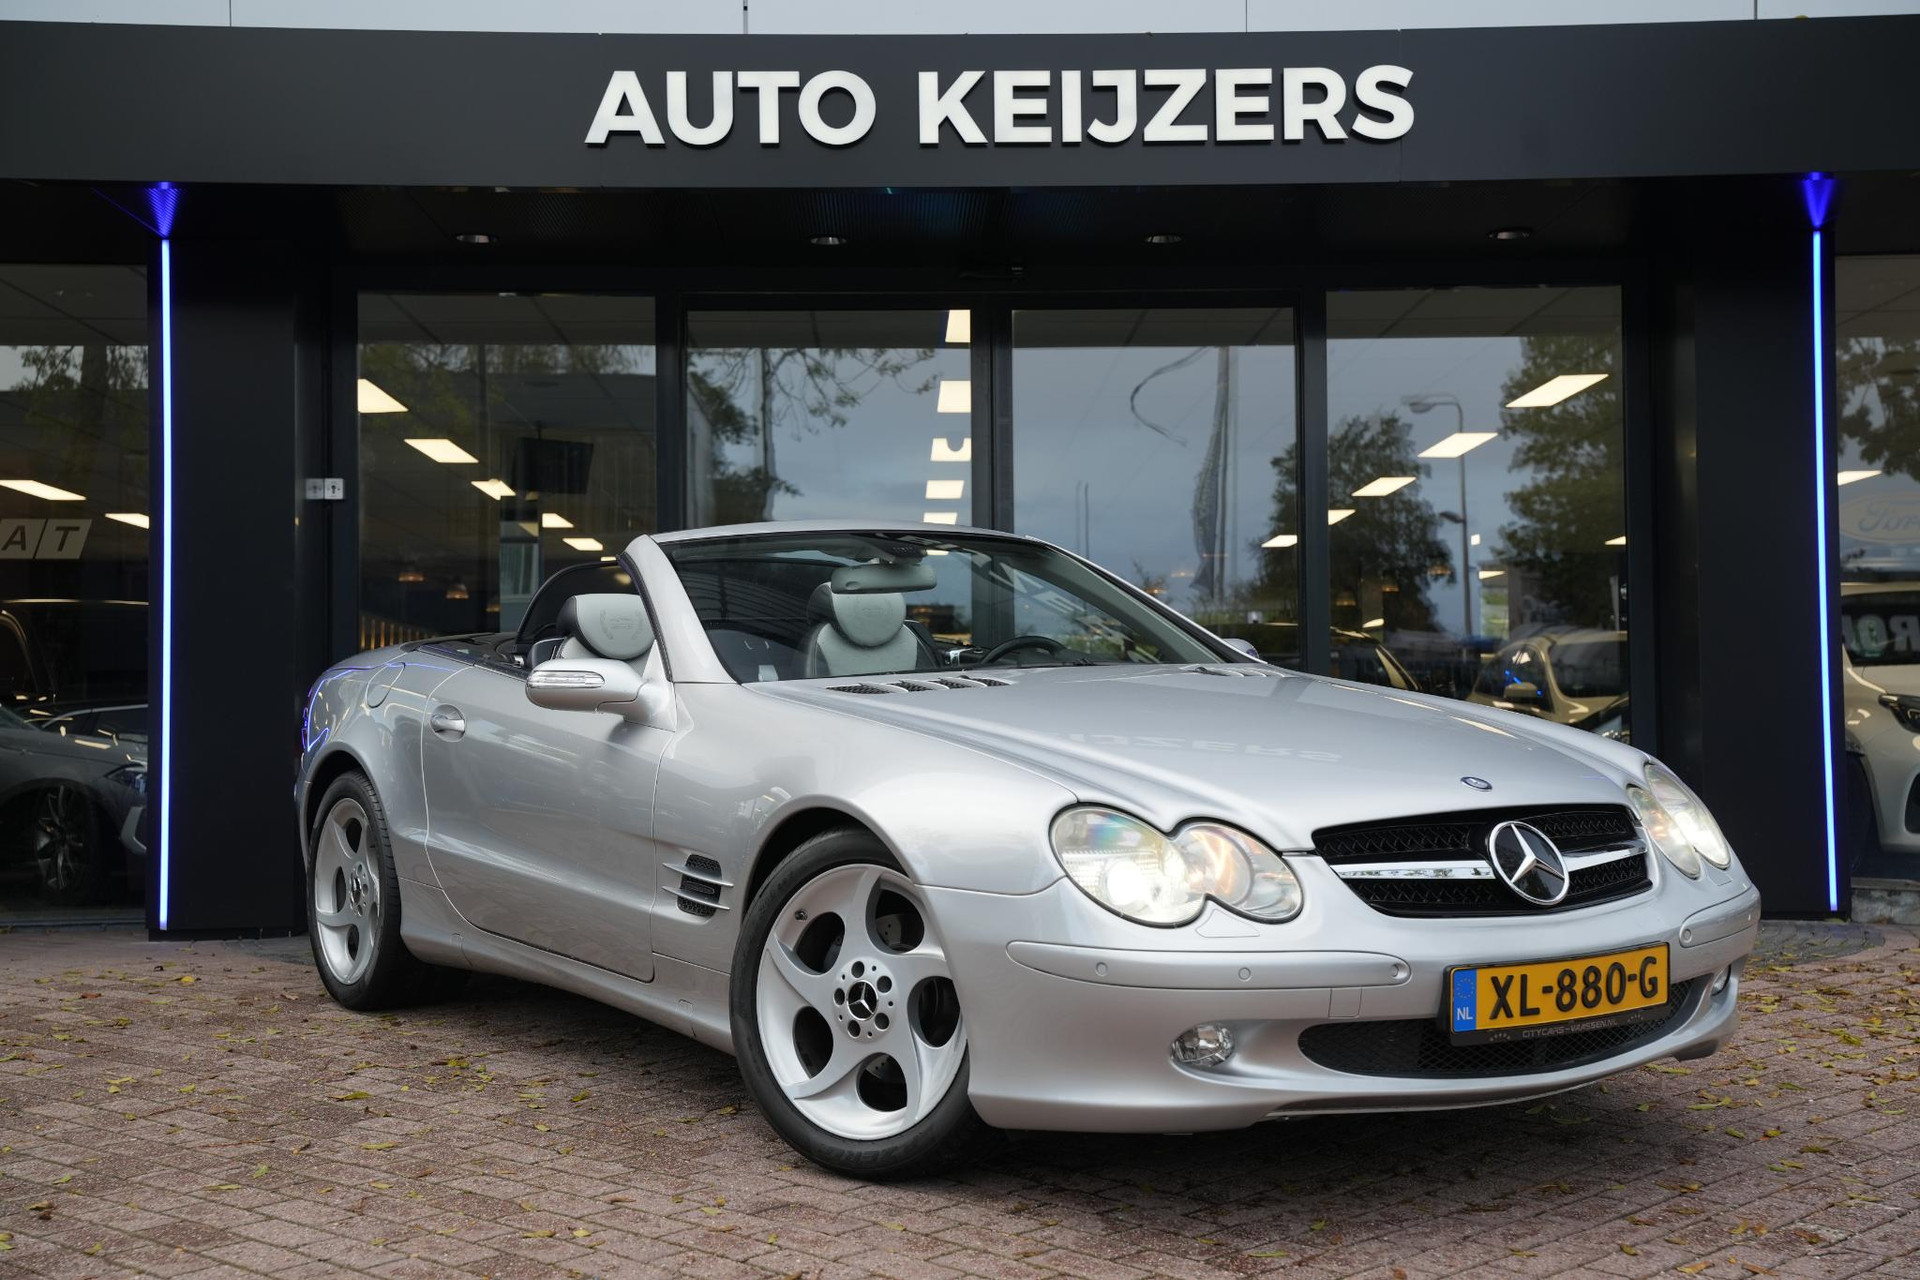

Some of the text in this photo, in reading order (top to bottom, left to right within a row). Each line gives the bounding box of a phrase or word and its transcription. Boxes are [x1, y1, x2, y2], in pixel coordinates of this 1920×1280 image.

[584, 65, 1415, 145] AUTO KEIJZERS
[1457, 1007, 1473, 1021] NL
[1489, 955, 1659, 1020] XL-880-G
